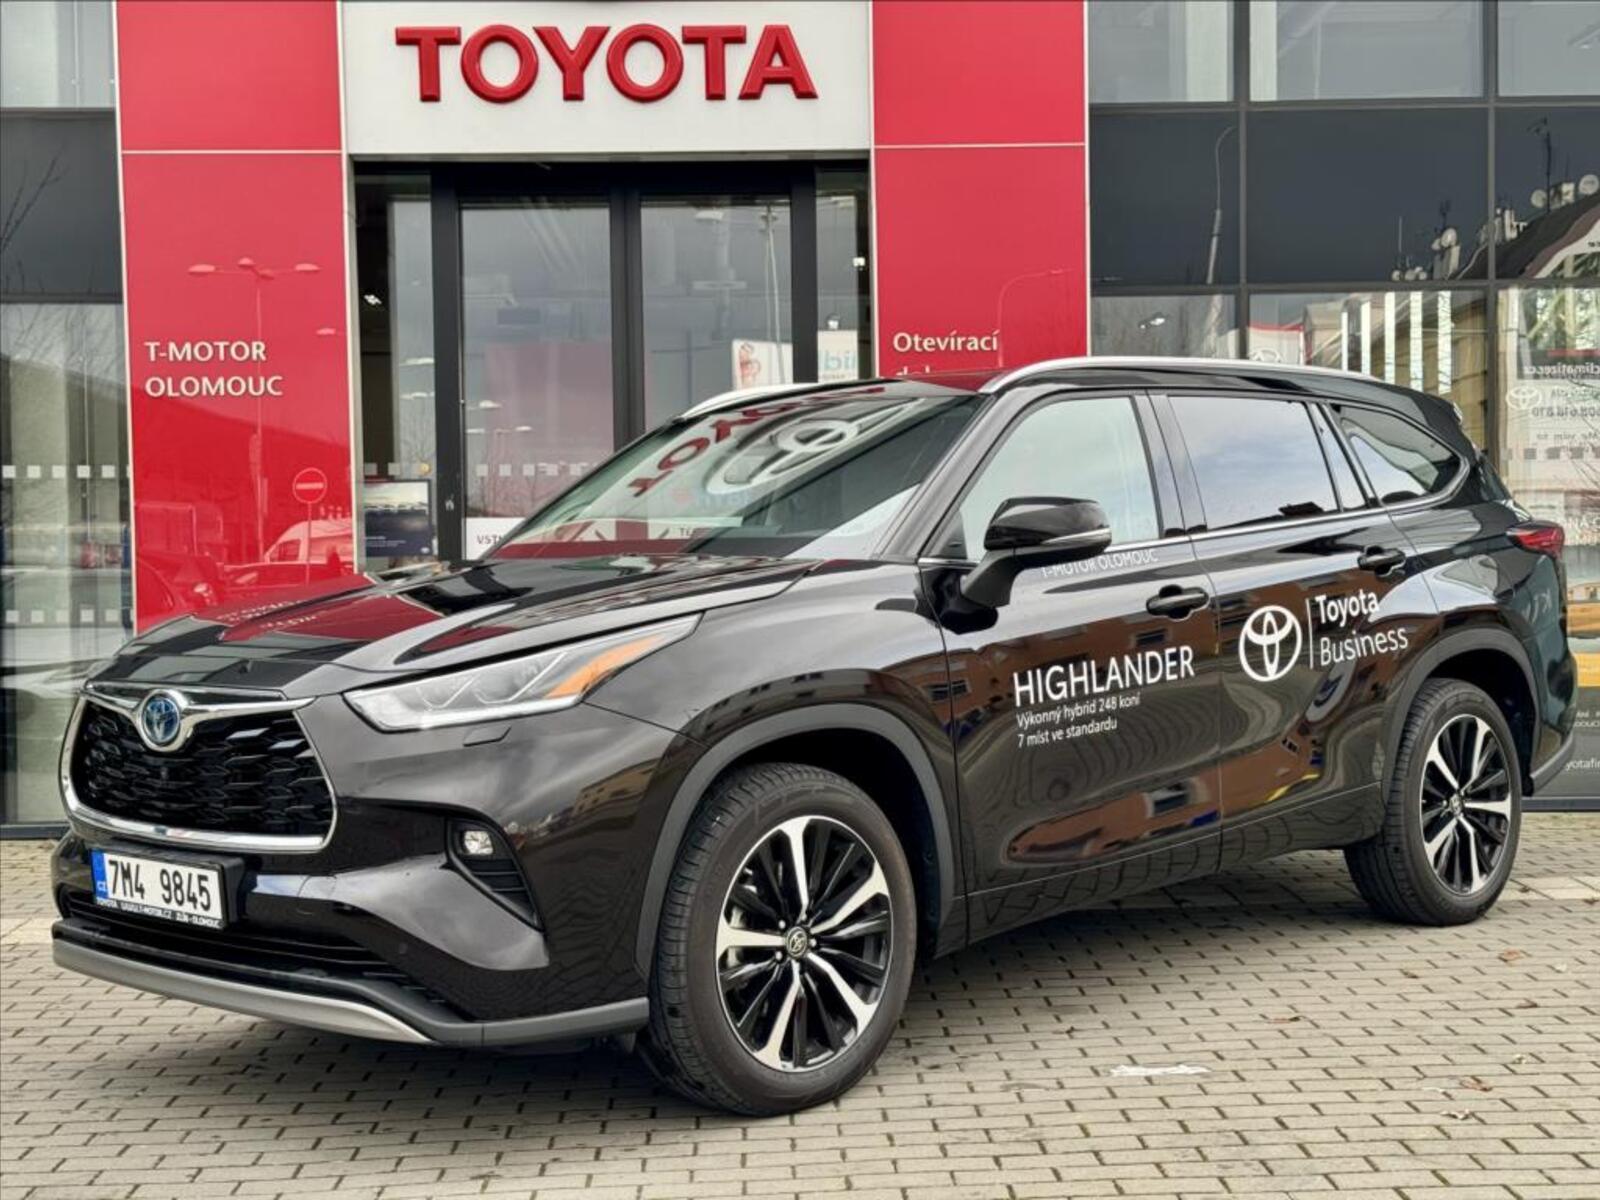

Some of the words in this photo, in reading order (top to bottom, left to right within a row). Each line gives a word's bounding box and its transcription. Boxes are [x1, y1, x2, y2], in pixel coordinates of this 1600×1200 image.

[395, 23, 819, 103] TOYOTA
[144, 340, 267, 362] T-MOTOR
[892, 329, 1000, 353] Otevírací
[144, 375, 283, 397] OLOMOUC
[476, 534, 502, 545] VST
[1099, 549, 1159, 570] OLOMOUC
[1315, 588, 1380, 627] Toyota
[1320, 626, 1409, 667] Business
[1013, 645, 1195, 708] HIGHLANDER
[1016, 707, 1062, 730] Výkonný
[1063, 700, 1097, 721] hybrid
[1099, 697, 1118, 712] 248
[1017, 733, 1025, 749] 7
[1051, 729, 1065, 742] ve
[1066, 717, 1117, 738] standardu
[108, 859, 145, 899] 7M4
[159, 868, 212, 912] 9845
